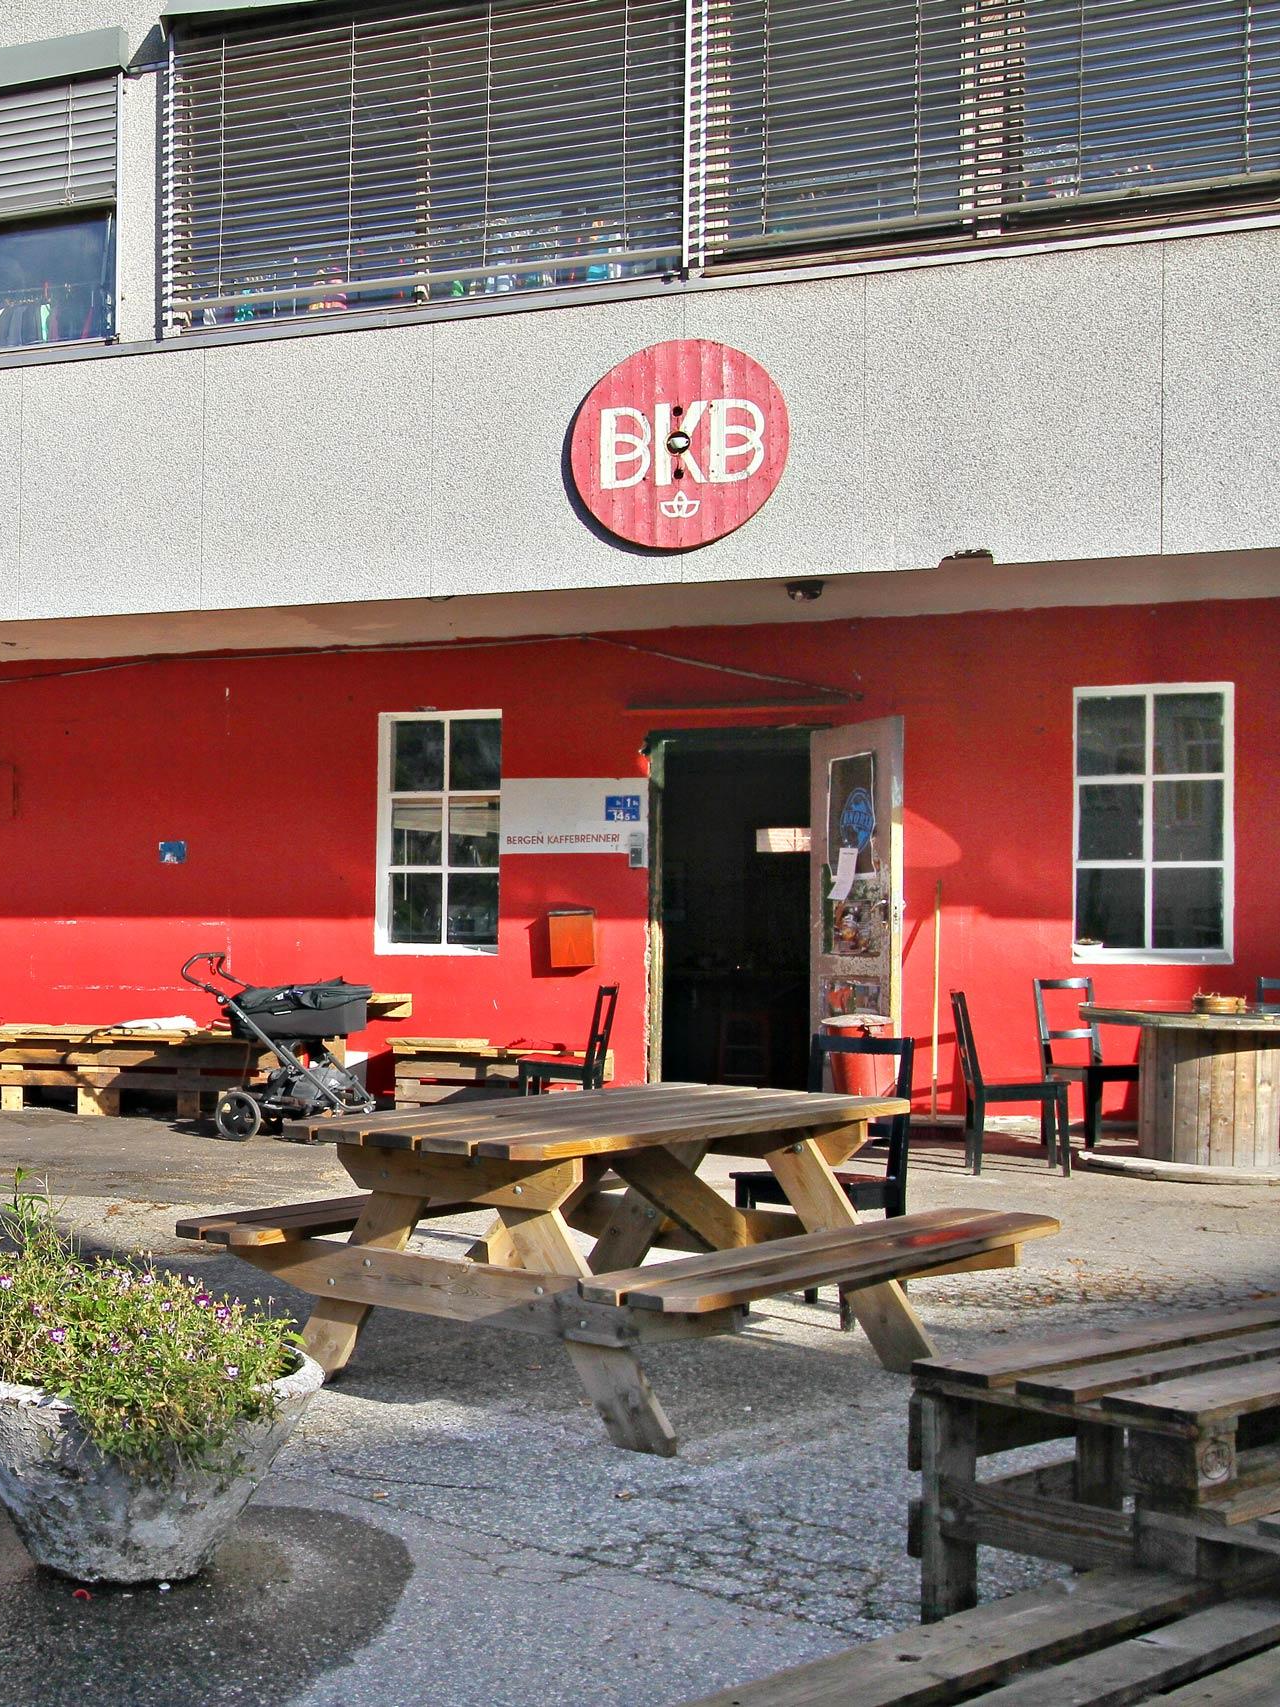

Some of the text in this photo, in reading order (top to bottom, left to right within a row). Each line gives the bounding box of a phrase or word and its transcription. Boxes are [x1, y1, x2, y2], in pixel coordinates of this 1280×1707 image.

[599, 397, 766, 490] BKB
[506, 833, 620, 845] BERGEN KAFFEBRENNERI
